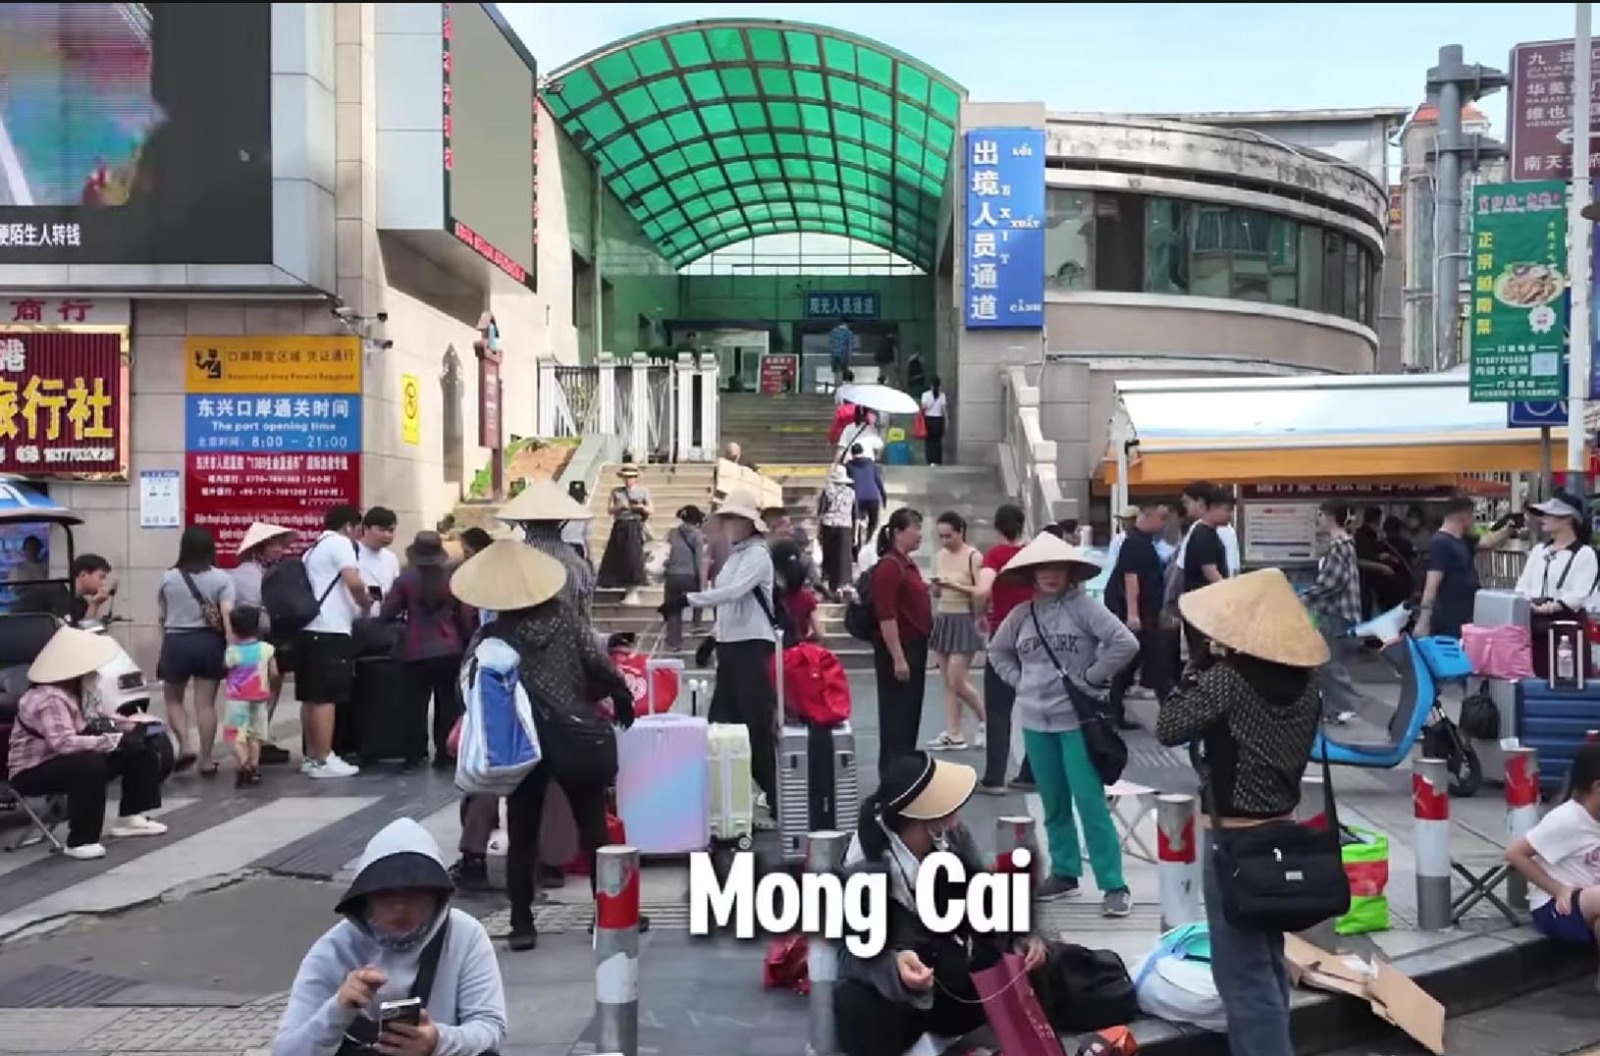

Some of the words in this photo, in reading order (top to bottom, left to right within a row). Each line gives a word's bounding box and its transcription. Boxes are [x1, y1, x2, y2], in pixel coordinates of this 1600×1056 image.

[971, 139, 999, 320] 出境人员通道
[10, 299, 94, 322] 商行
[197, 398, 349, 418] 东兴口岸通关时间
[212, 421, 232, 431] The
[235, 421, 258, 433] port
[262, 421, 308, 433] opening
[311, 421, 336, 431] time
[251, 436, 283, 447] 8:00
[307, 436, 348, 447] 21:00
